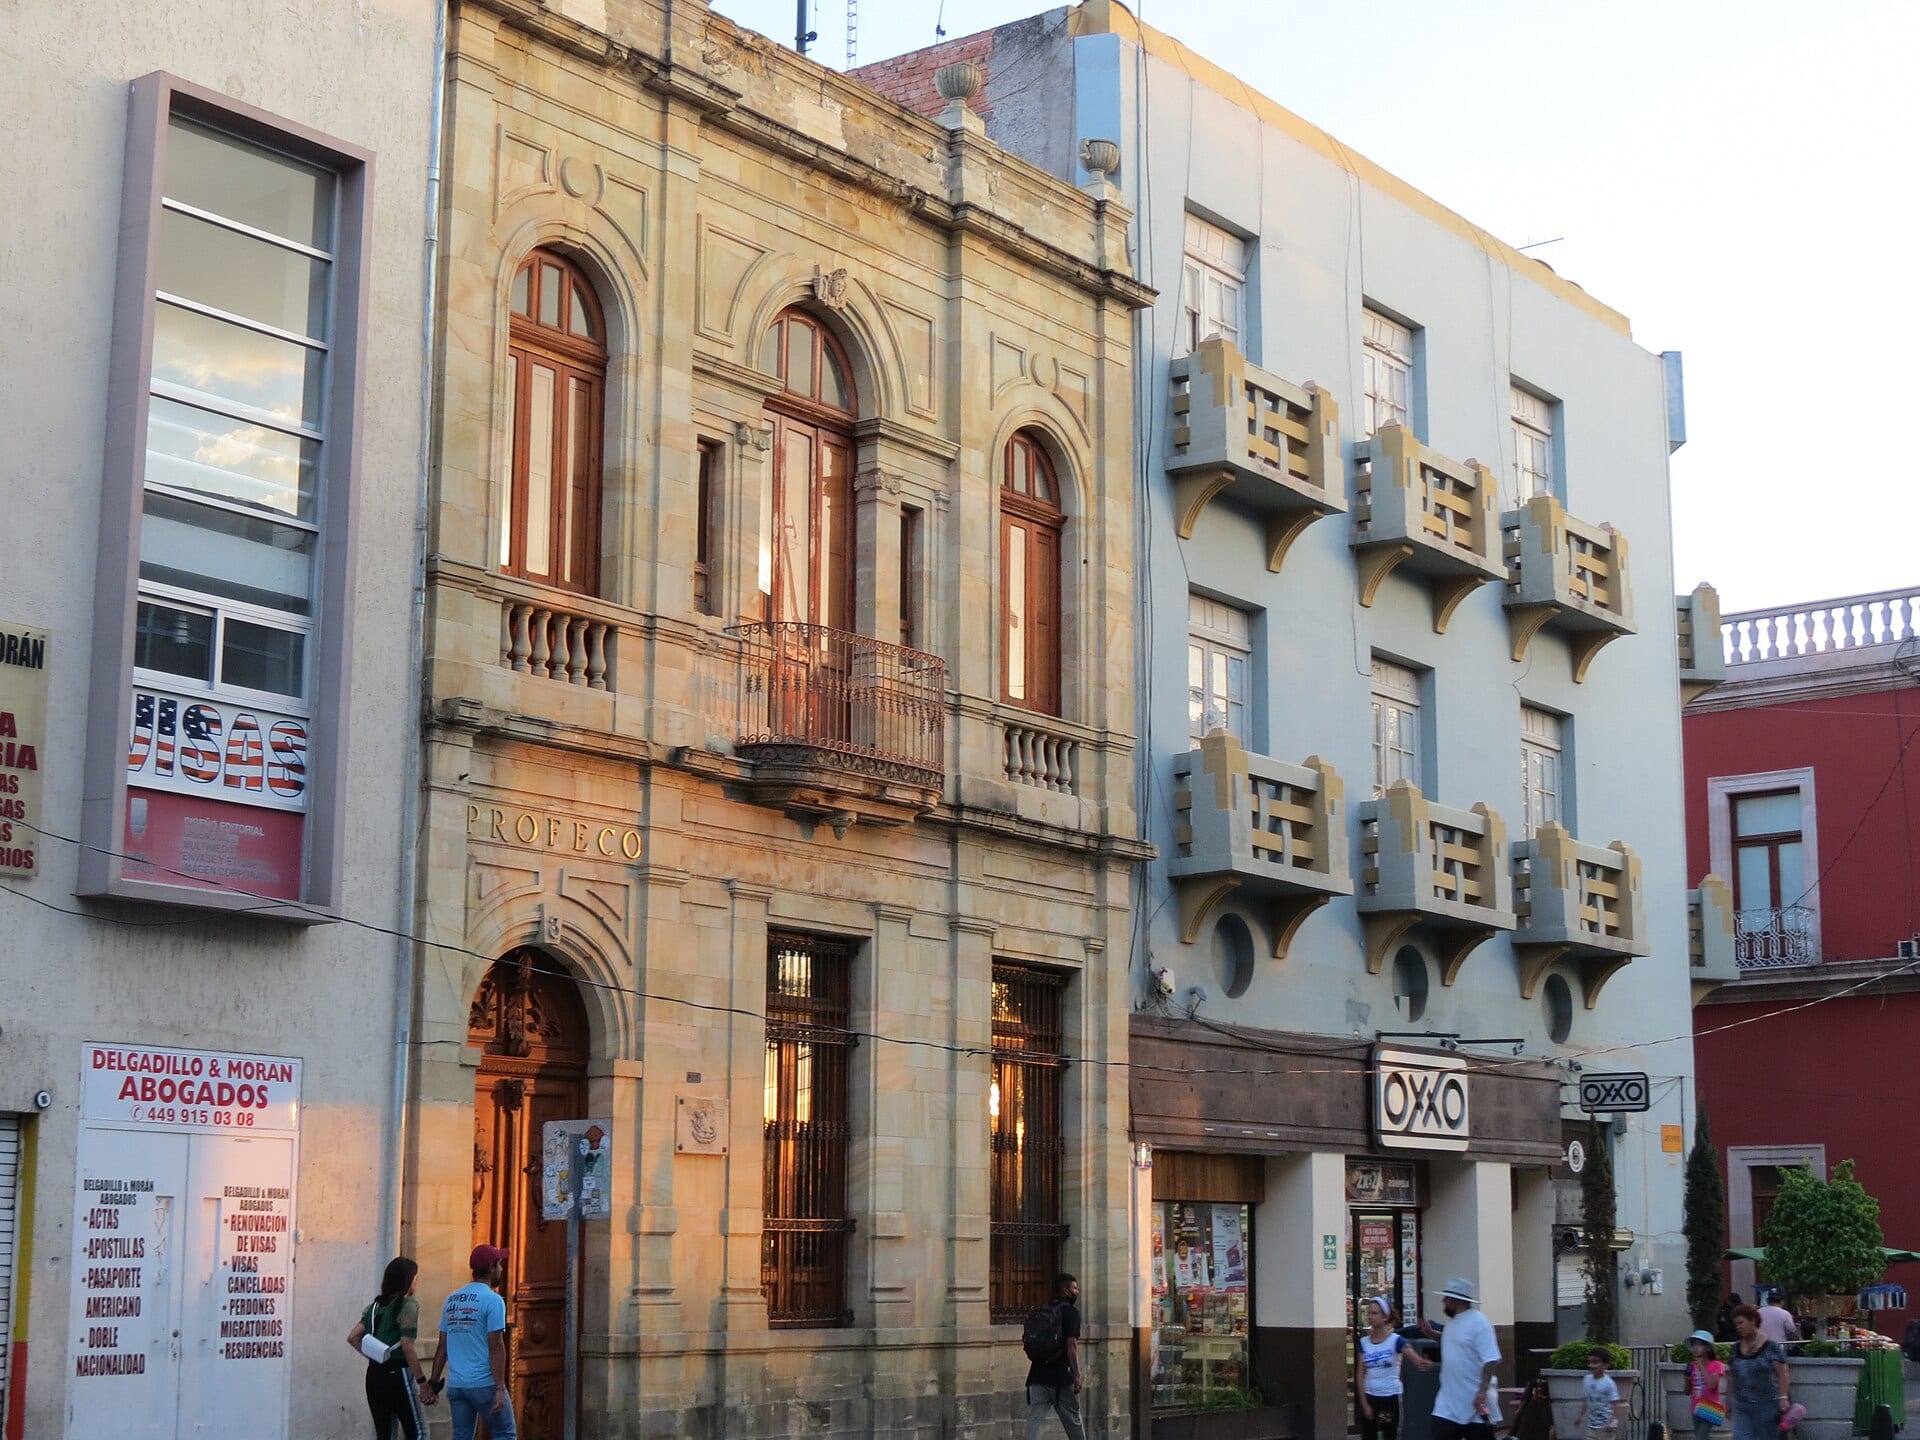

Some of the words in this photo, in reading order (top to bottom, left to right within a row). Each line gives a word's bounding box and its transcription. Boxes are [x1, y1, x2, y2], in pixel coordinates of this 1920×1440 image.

[128, 694, 308, 797] VISAS
[219, 821, 265, 837] EDITORIAL
[467, 805, 642, 859] PROFECO
[93, 1050, 203, 1076] DELGADILLO
[209, 1059, 221, 1077] &
[228, 1060, 292, 1083] MORAN
[118, 1076, 268, 1109] ABOGADOS
[1384, 1071, 1465, 1131] OXXO
[1584, 1081, 1643, 1104] OXXO
[148, 1107, 175, 1121] 449
[181, 1109, 208, 1123] 915
[214, 1111, 231, 1125] 03
[237, 1112, 254, 1126] 08
[84, 1179, 122, 1191] DELGADILLO
[130, 1179, 154, 1192] MORÁN
[100, 1193, 137, 1205] ABOGADOS
[240, 1200, 273, 1211] ABOGADOS
[89, 1208, 119, 1229] ACTAS
[88, 1237, 145, 1259] APOSTILLAS
[237, 1235, 248, 1252] DE
[250, 1236, 277, 1253] VISAS
[232, 1256, 258, 1273] VISAS
[88, 1267, 141, 1289] PASAPORTE
[228, 1276, 285, 1294] CANCELADAS
[86, 1296, 141, 1318] AMERICANO
[229, 1298, 275, 1315] PERDONES
[89, 1326, 118, 1348] DOBLE
[221, 1320, 283, 1338] MIGRATORIOS
[225, 1341, 284, 1360] RESIDENCIAS
[76, 1354, 145, 1377] NACIONALIDAD
